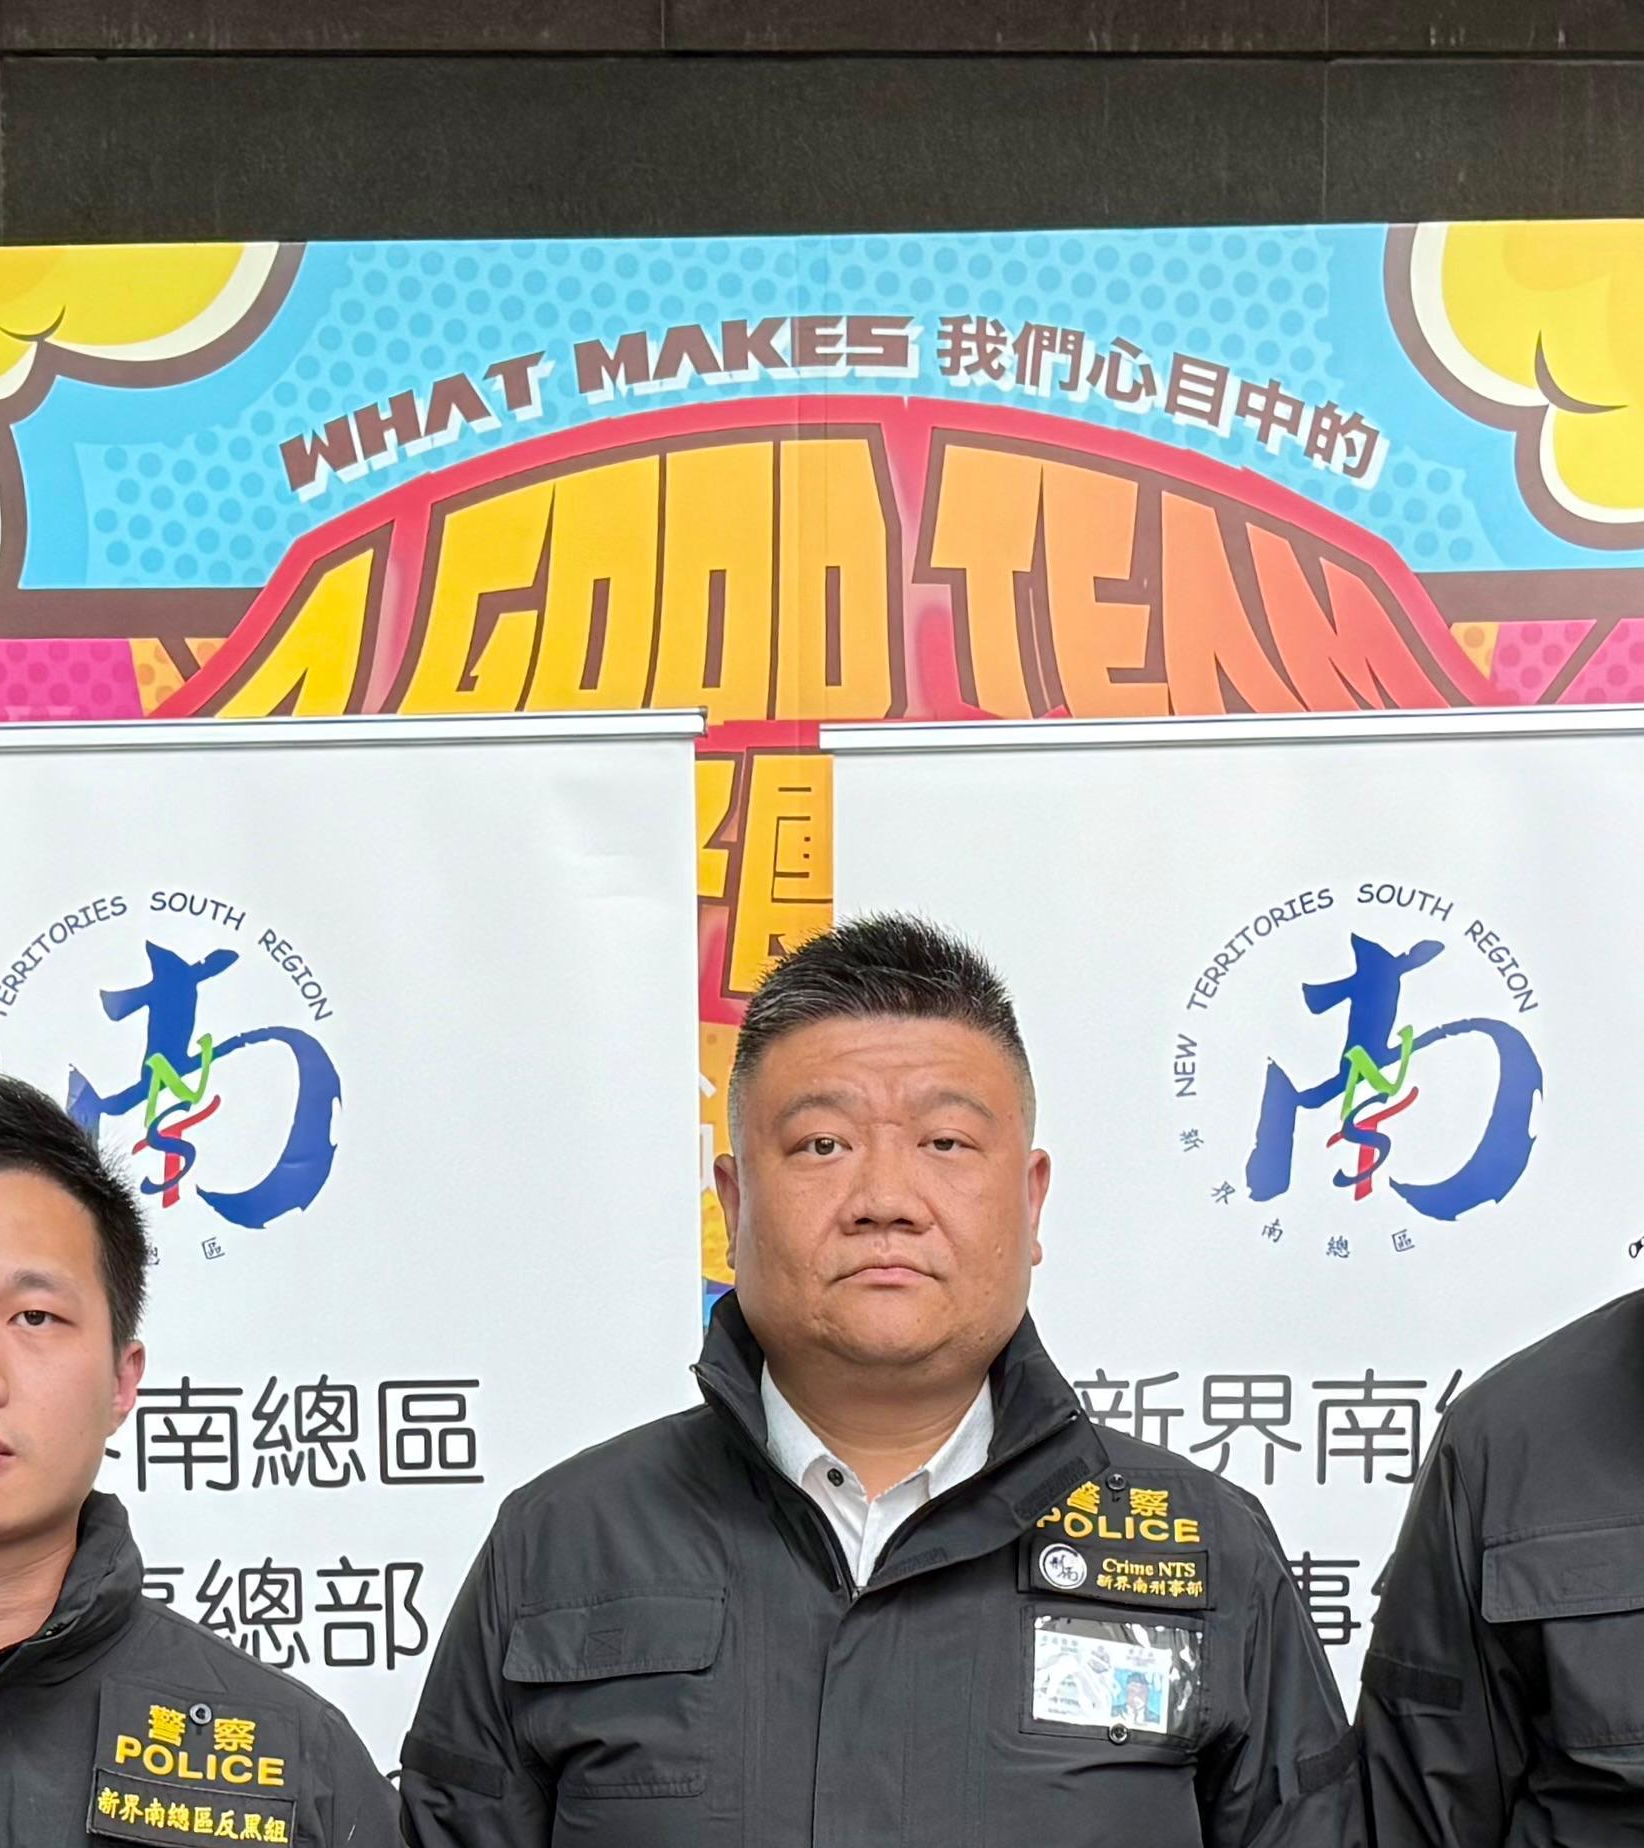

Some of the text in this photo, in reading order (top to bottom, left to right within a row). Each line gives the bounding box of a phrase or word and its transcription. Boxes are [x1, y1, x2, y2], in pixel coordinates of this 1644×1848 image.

[280, 312, 1385, 494] WHAT MAKES 我們心目中的
[412, 436, 902, 720] GOOD
[919, 440, 1449, 720] TEAM
[150, 892, 245, 930] SOUTH
[258, 929, 333, 1021] REGION
[1174, 884, 1538, 1097] NEW TERRITORIES SOUTH REGION
[103, 1374, 486, 1492] 南總區
[1067, 1480, 1168, 1517] 警察
[1102, 1559, 1195, 1578] Crime NTS
[115, 1734, 285, 1786] POLICE
[147, 1704, 256, 1753] 警察
[97, 1787, 289, 1844] 新界南總區反黑組
